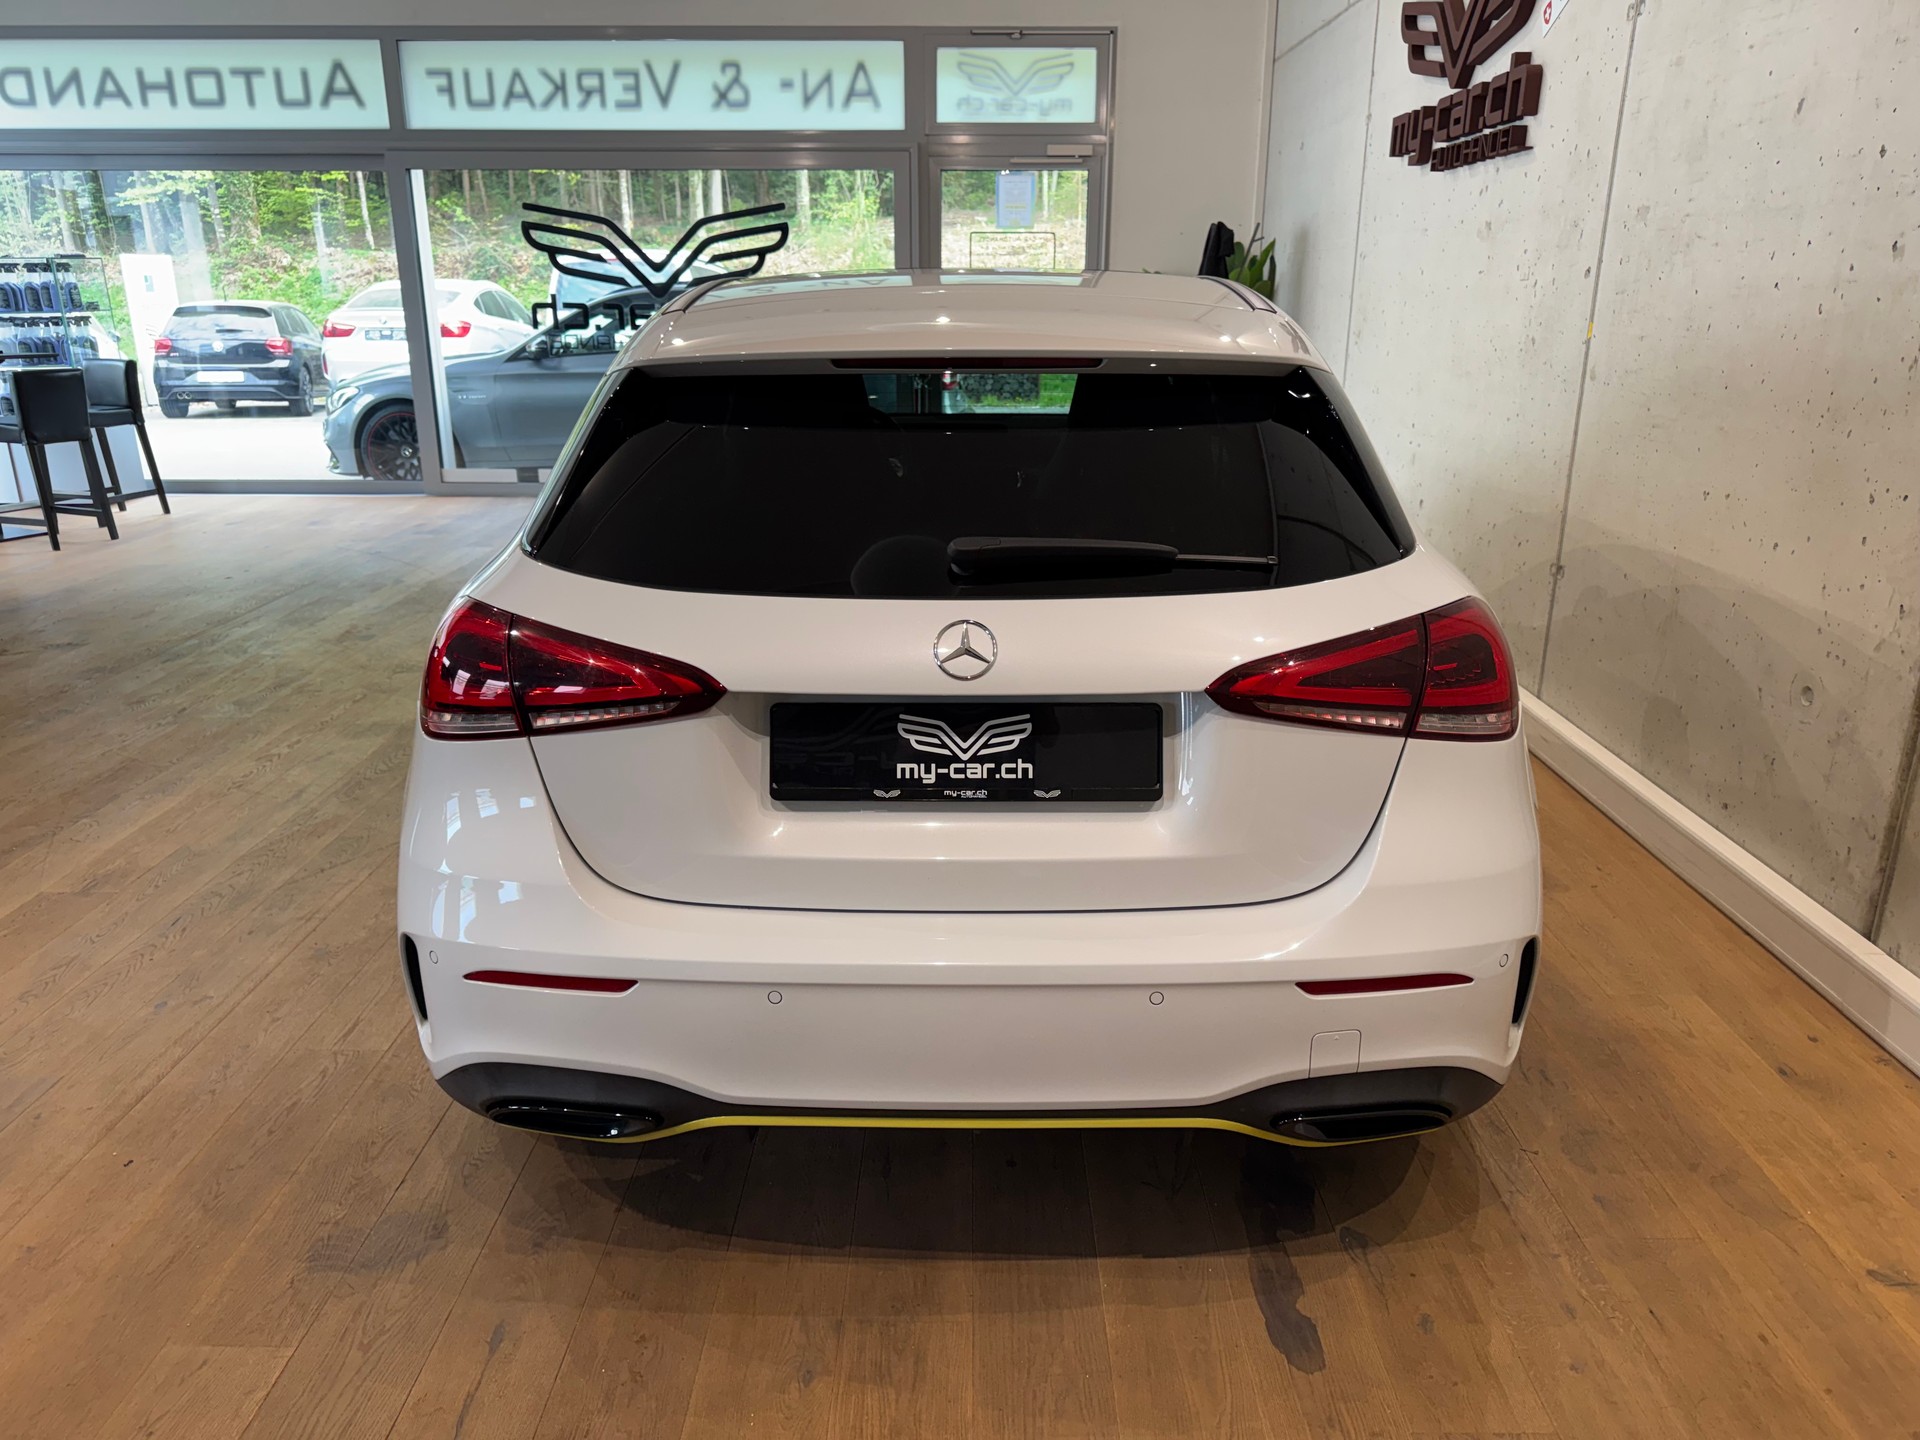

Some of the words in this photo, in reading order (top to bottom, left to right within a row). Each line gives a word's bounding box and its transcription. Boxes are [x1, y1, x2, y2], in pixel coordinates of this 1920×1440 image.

[1389, 52, 1543, 166] my-car.ch
[896, 758, 1033, 784] my-car.ch
[943, 789, 988, 797] my-car.ch
